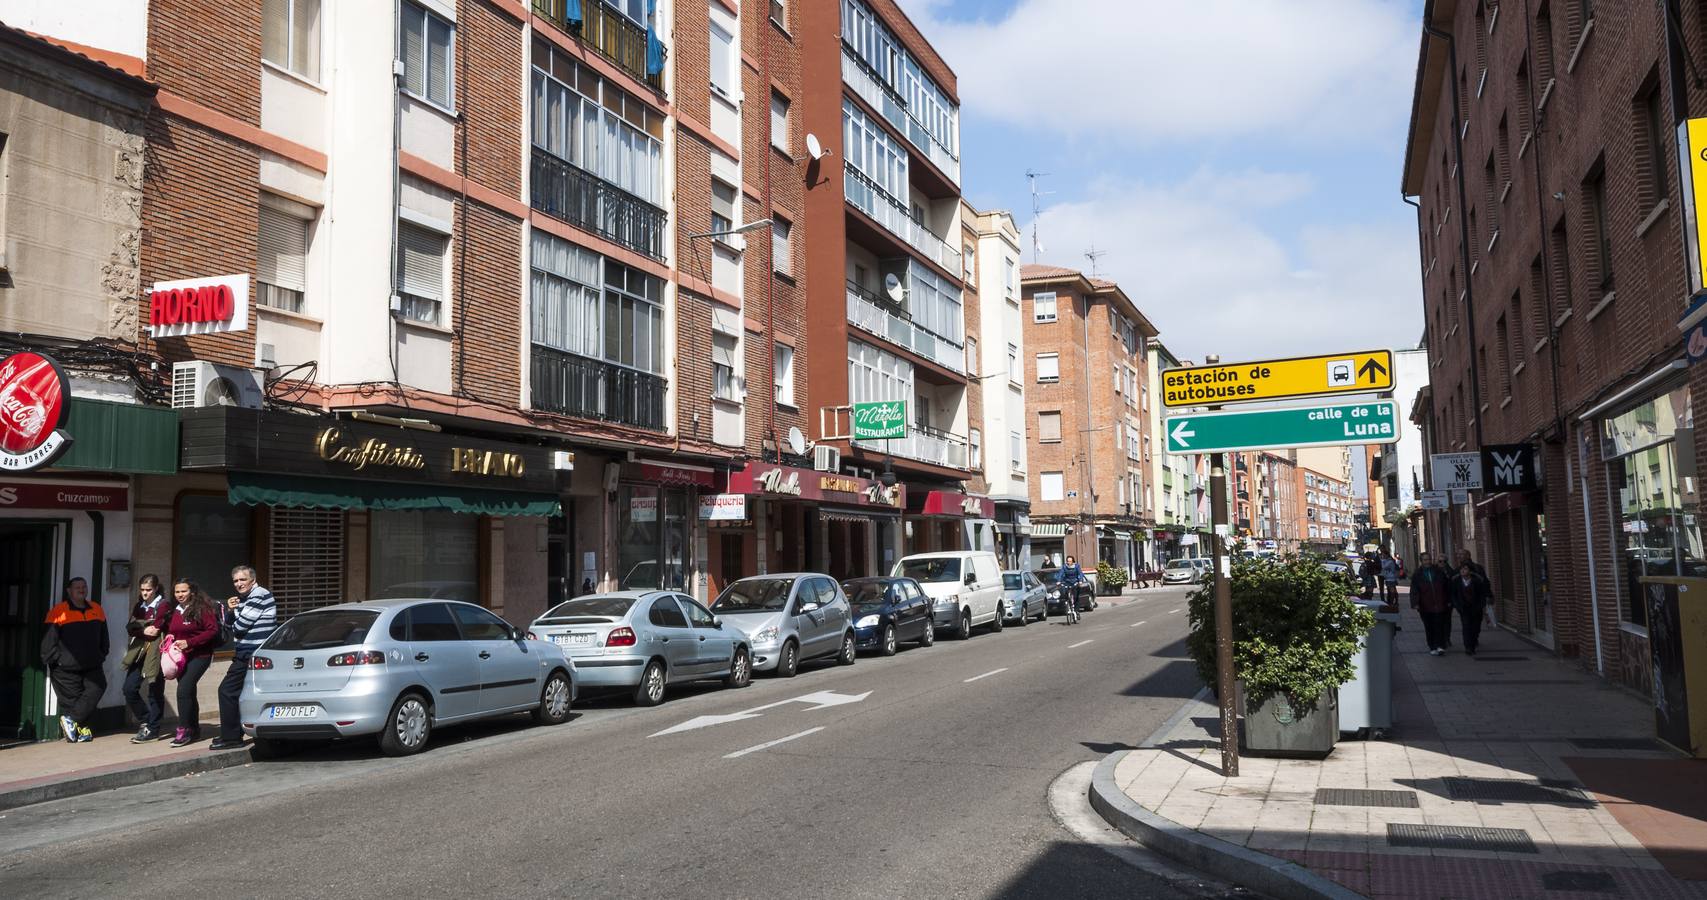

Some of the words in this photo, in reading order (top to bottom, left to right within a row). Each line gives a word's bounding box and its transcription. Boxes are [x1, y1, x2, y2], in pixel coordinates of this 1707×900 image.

[150, 284, 234, 327] HORNO
[1166, 367, 1238, 387] estación
[1249, 366, 1271, 380] de
[1167, 383, 1256, 401] autobuses
[1308, 408, 1343, 421] calle
[1351, 406, 1369, 418] de
[1377, 404, 1391, 416] la
[856, 424, 904, 437] RESTAURANTE
[1343, 421, 1392, 437] Luna
[3, 457, 19, 467] BAR
[24, 442, 53, 465] TORRES
[451, 447, 525, 477] BRAVO
[1491, 450, 1523, 486] WMF
[57, 492, 110, 504] Cruzcampo
[275, 707, 297, 717] 9770
[298, 706, 316, 716] FLP
